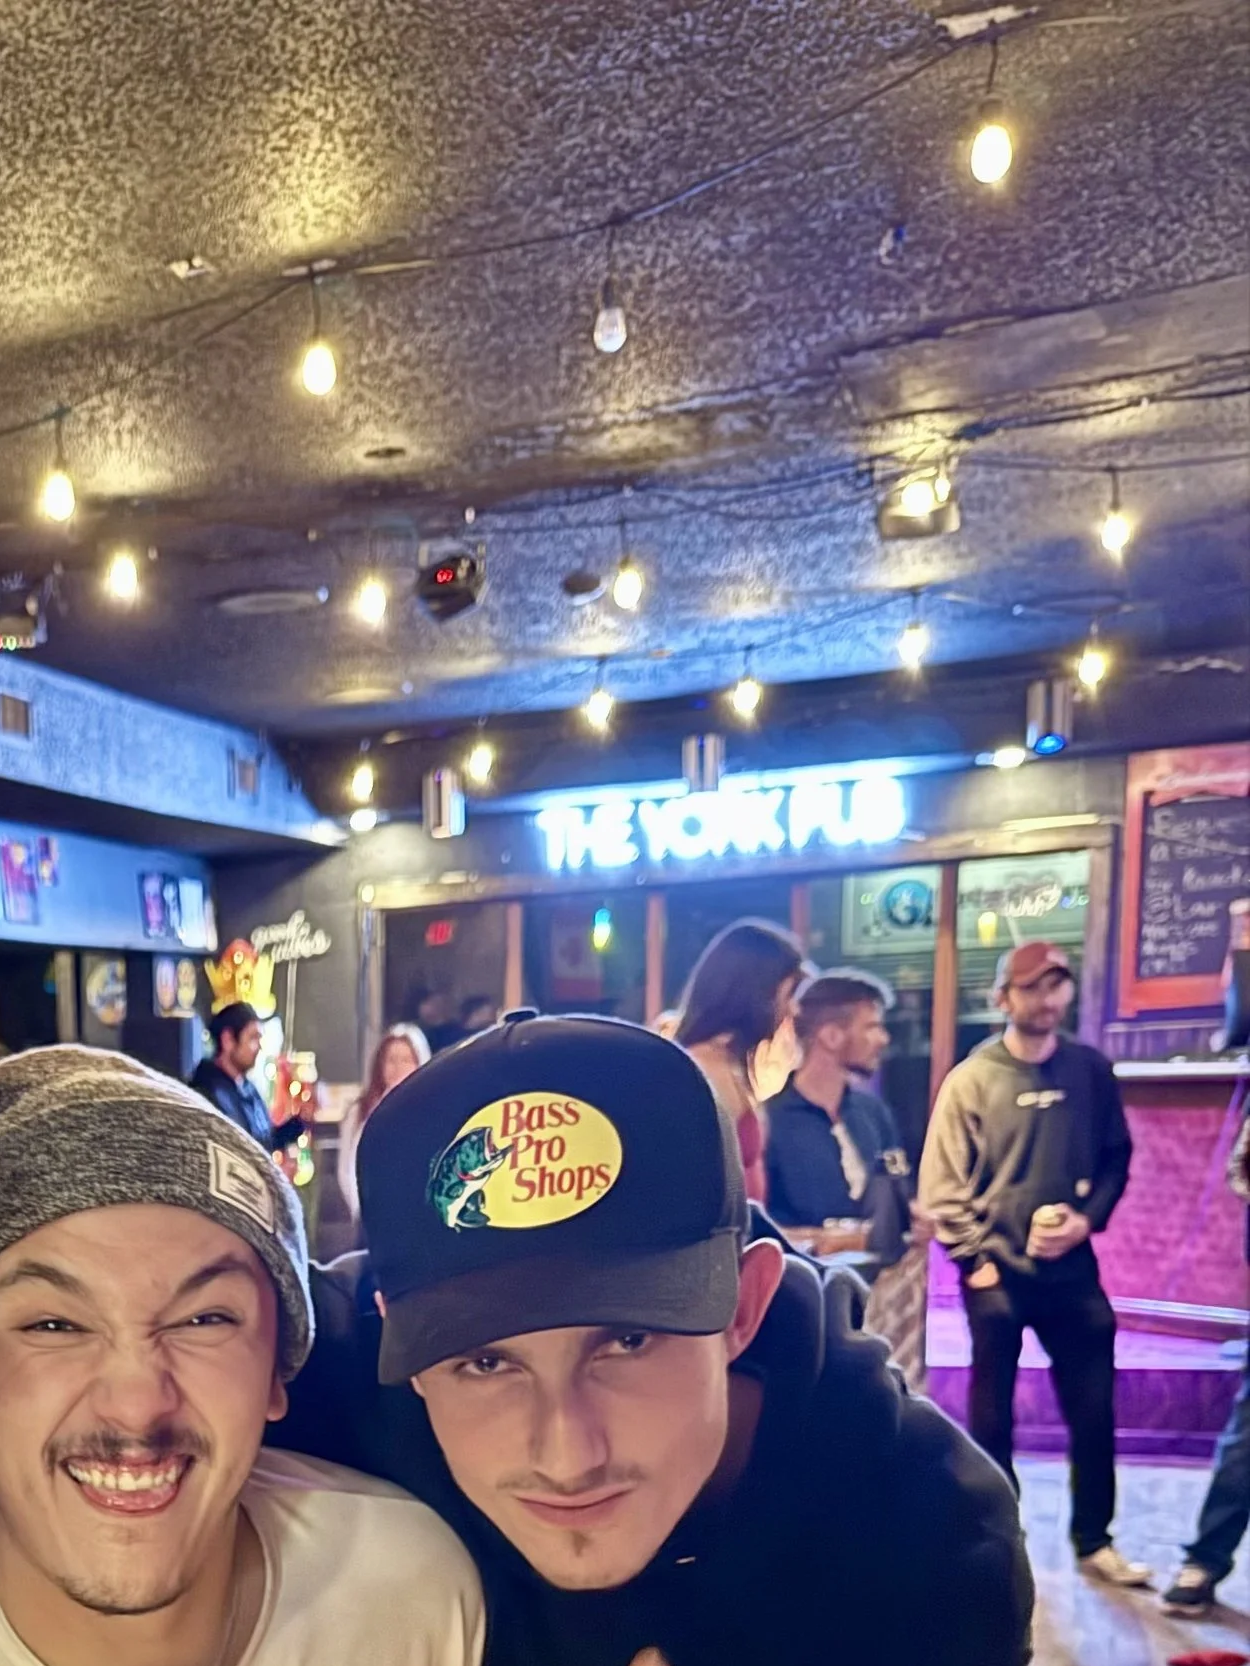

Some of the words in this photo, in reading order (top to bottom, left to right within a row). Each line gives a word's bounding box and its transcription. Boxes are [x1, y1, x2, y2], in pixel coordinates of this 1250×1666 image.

[500, 1099, 581, 1138] Bass
[509, 1134, 566, 1170] Pro
[511, 1162, 611, 1203] Shops
